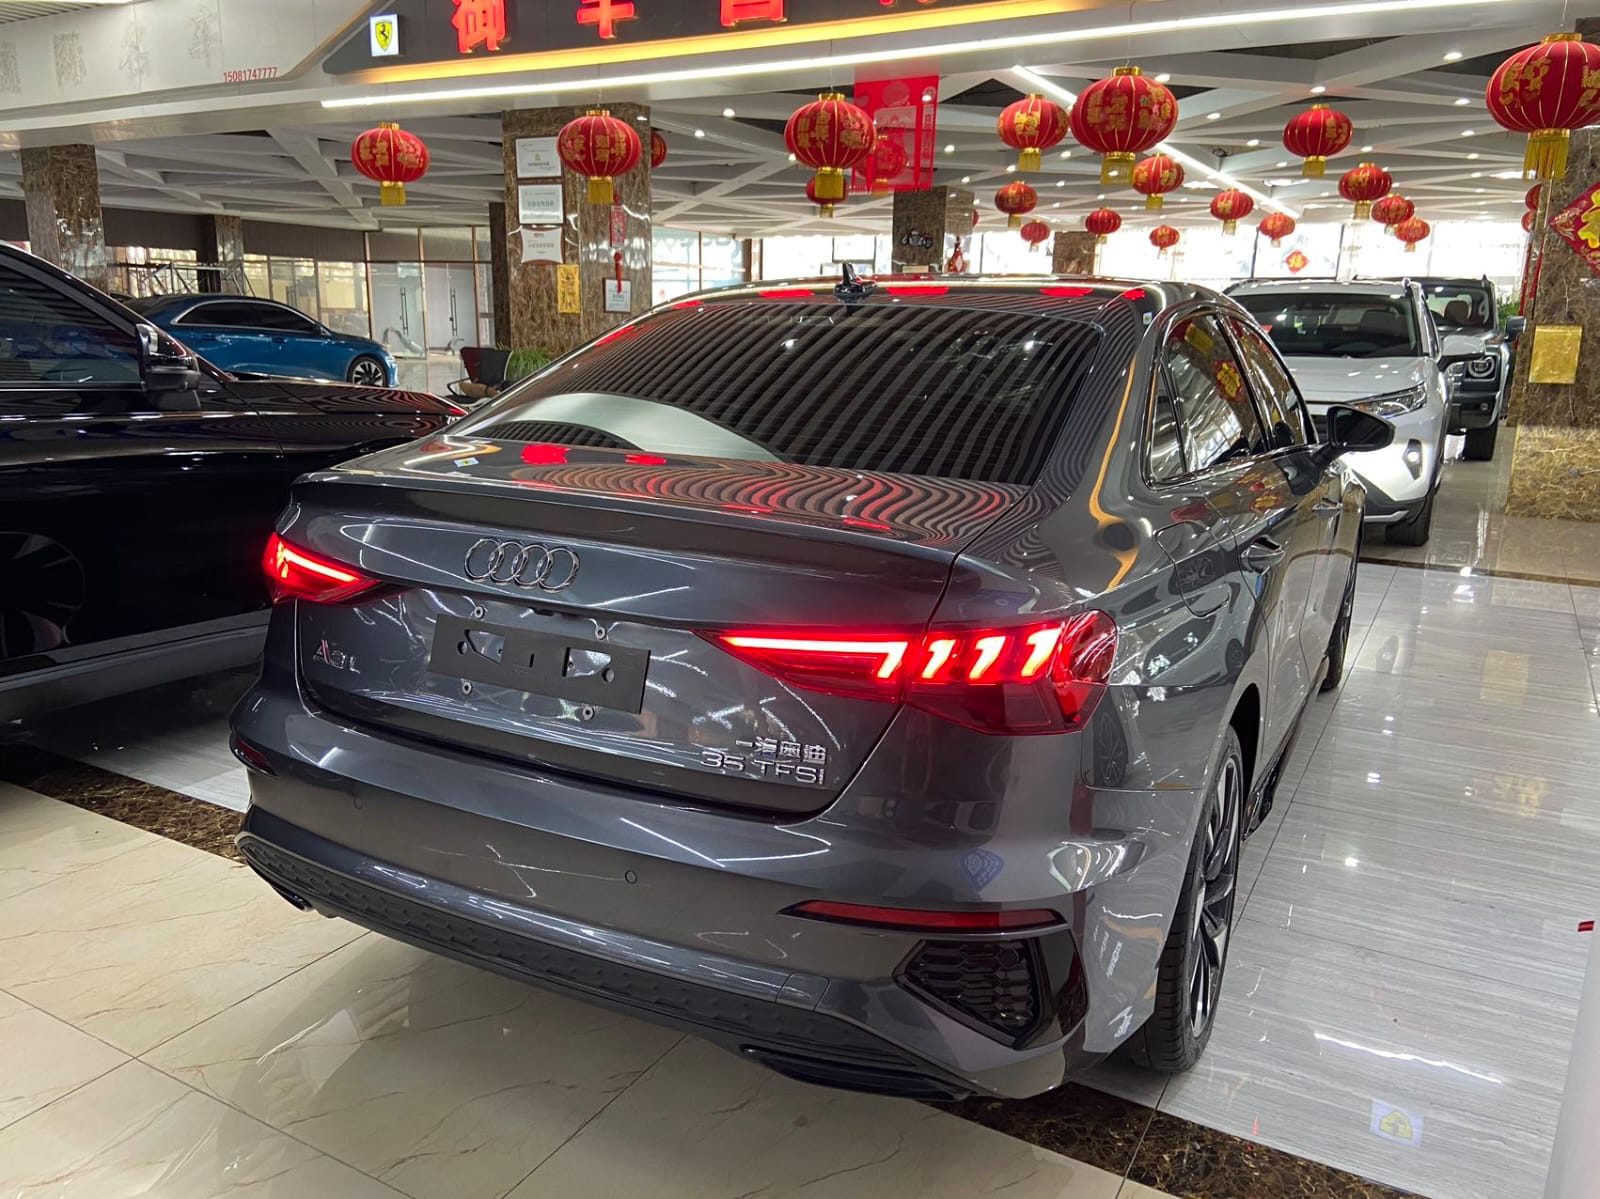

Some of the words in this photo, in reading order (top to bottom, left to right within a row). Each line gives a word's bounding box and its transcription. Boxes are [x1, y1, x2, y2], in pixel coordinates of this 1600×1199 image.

[223, 66, 278, 83] 15081747777
[735, 735, 827, 765] 一汽奥迪
[700, 750, 745, 772] 35
[751, 758, 825, 785] TFSI
